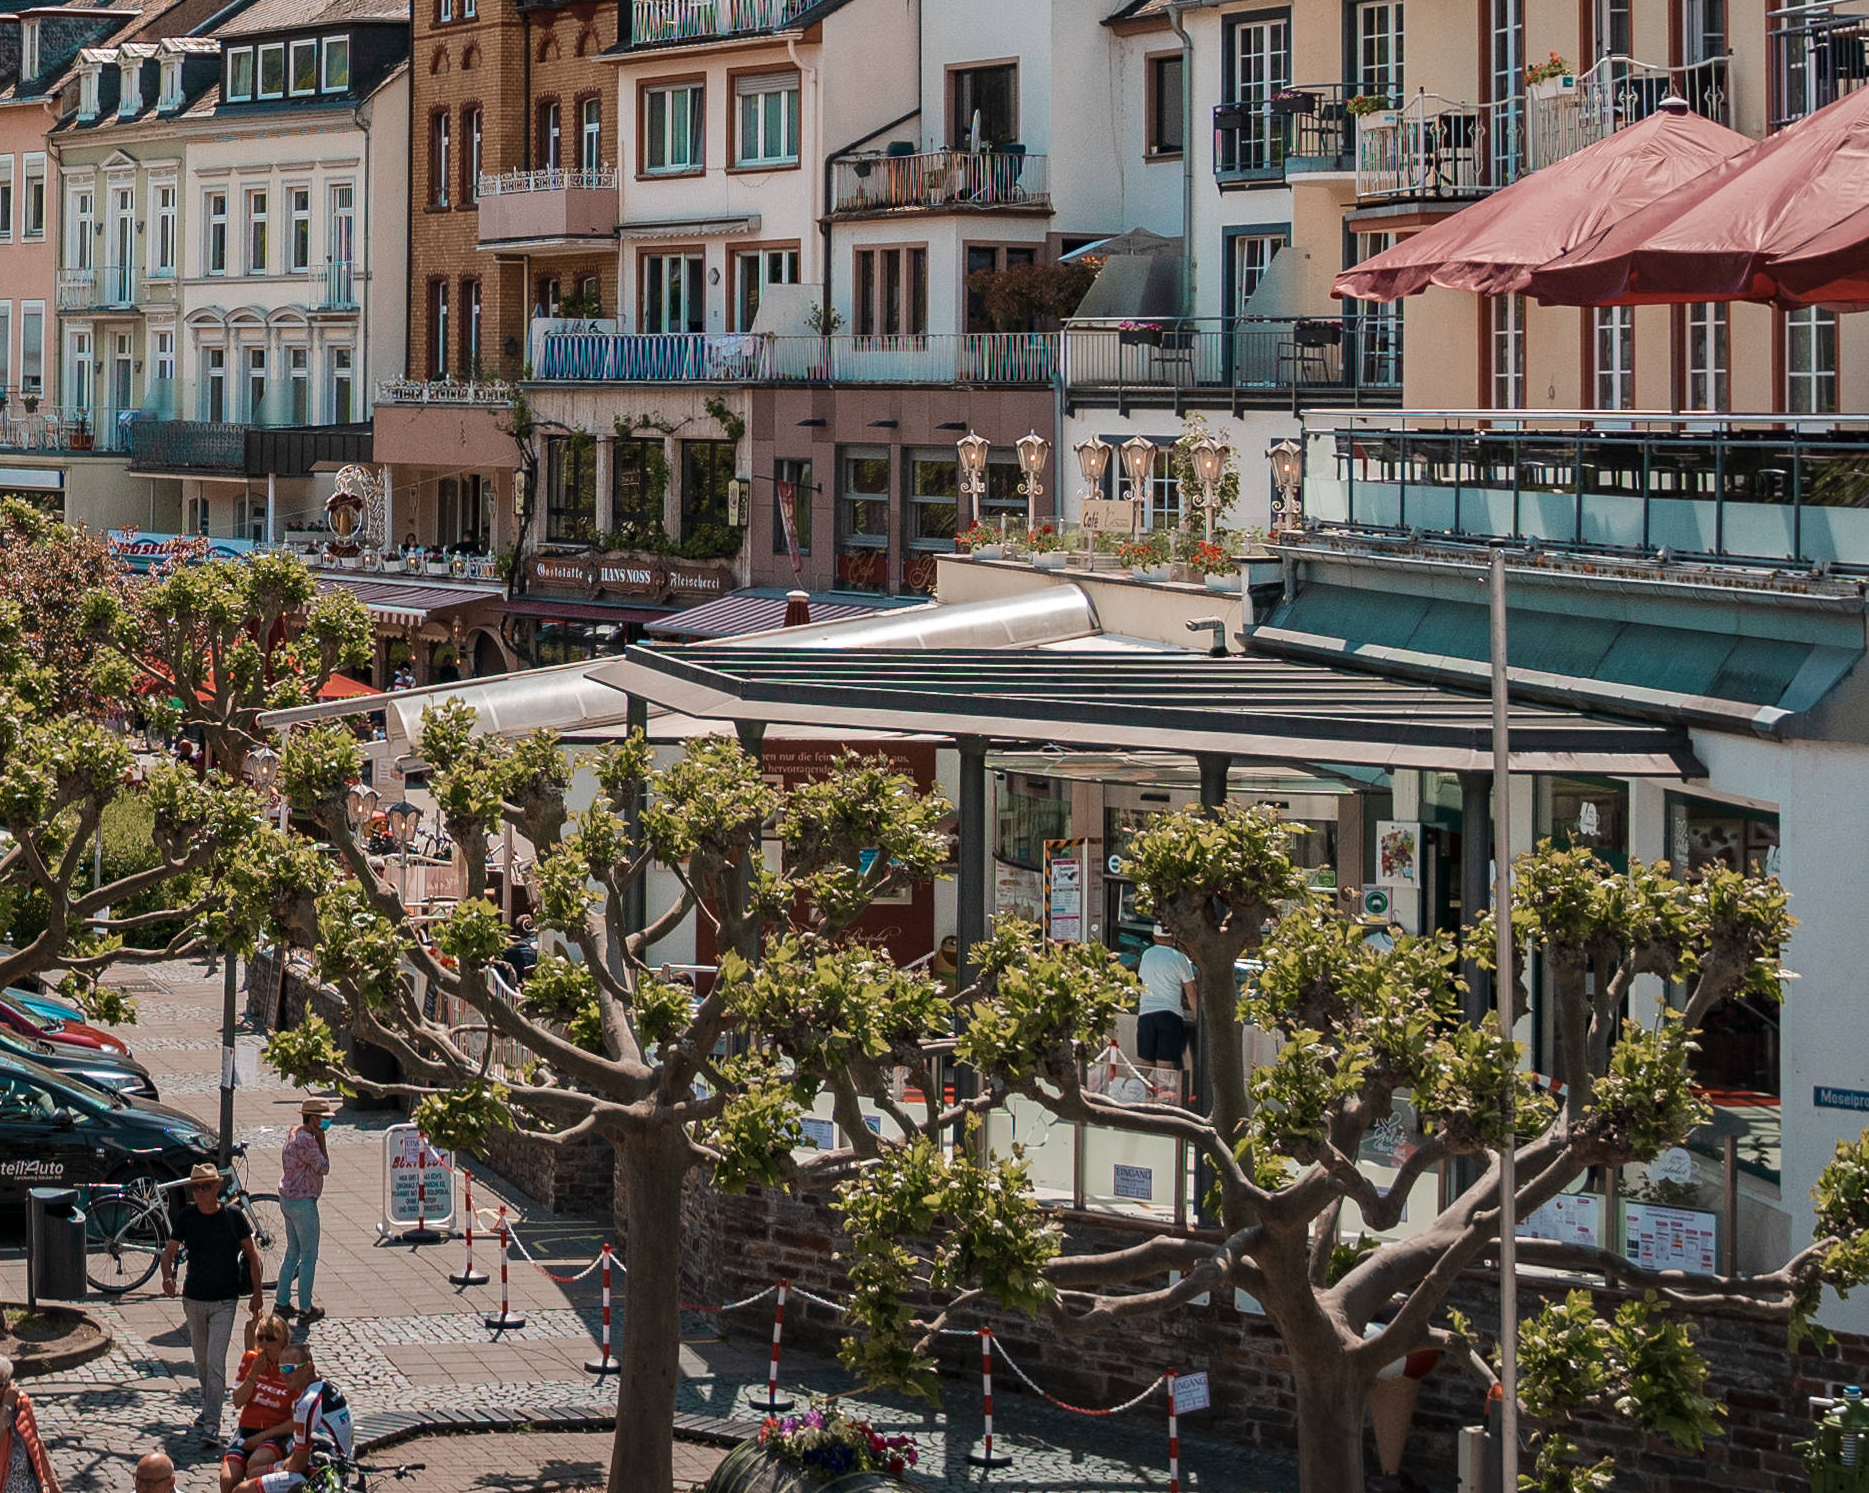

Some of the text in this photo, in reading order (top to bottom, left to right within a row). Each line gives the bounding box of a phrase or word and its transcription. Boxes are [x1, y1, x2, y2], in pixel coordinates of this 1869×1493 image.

[537, 562, 720, 590] Gaststätte HANS NOSS Fleischerei
[779, 752, 796, 762] nur
[797, 751, 812, 762] die
[0, 1160, 64, 1175] teilAuto
